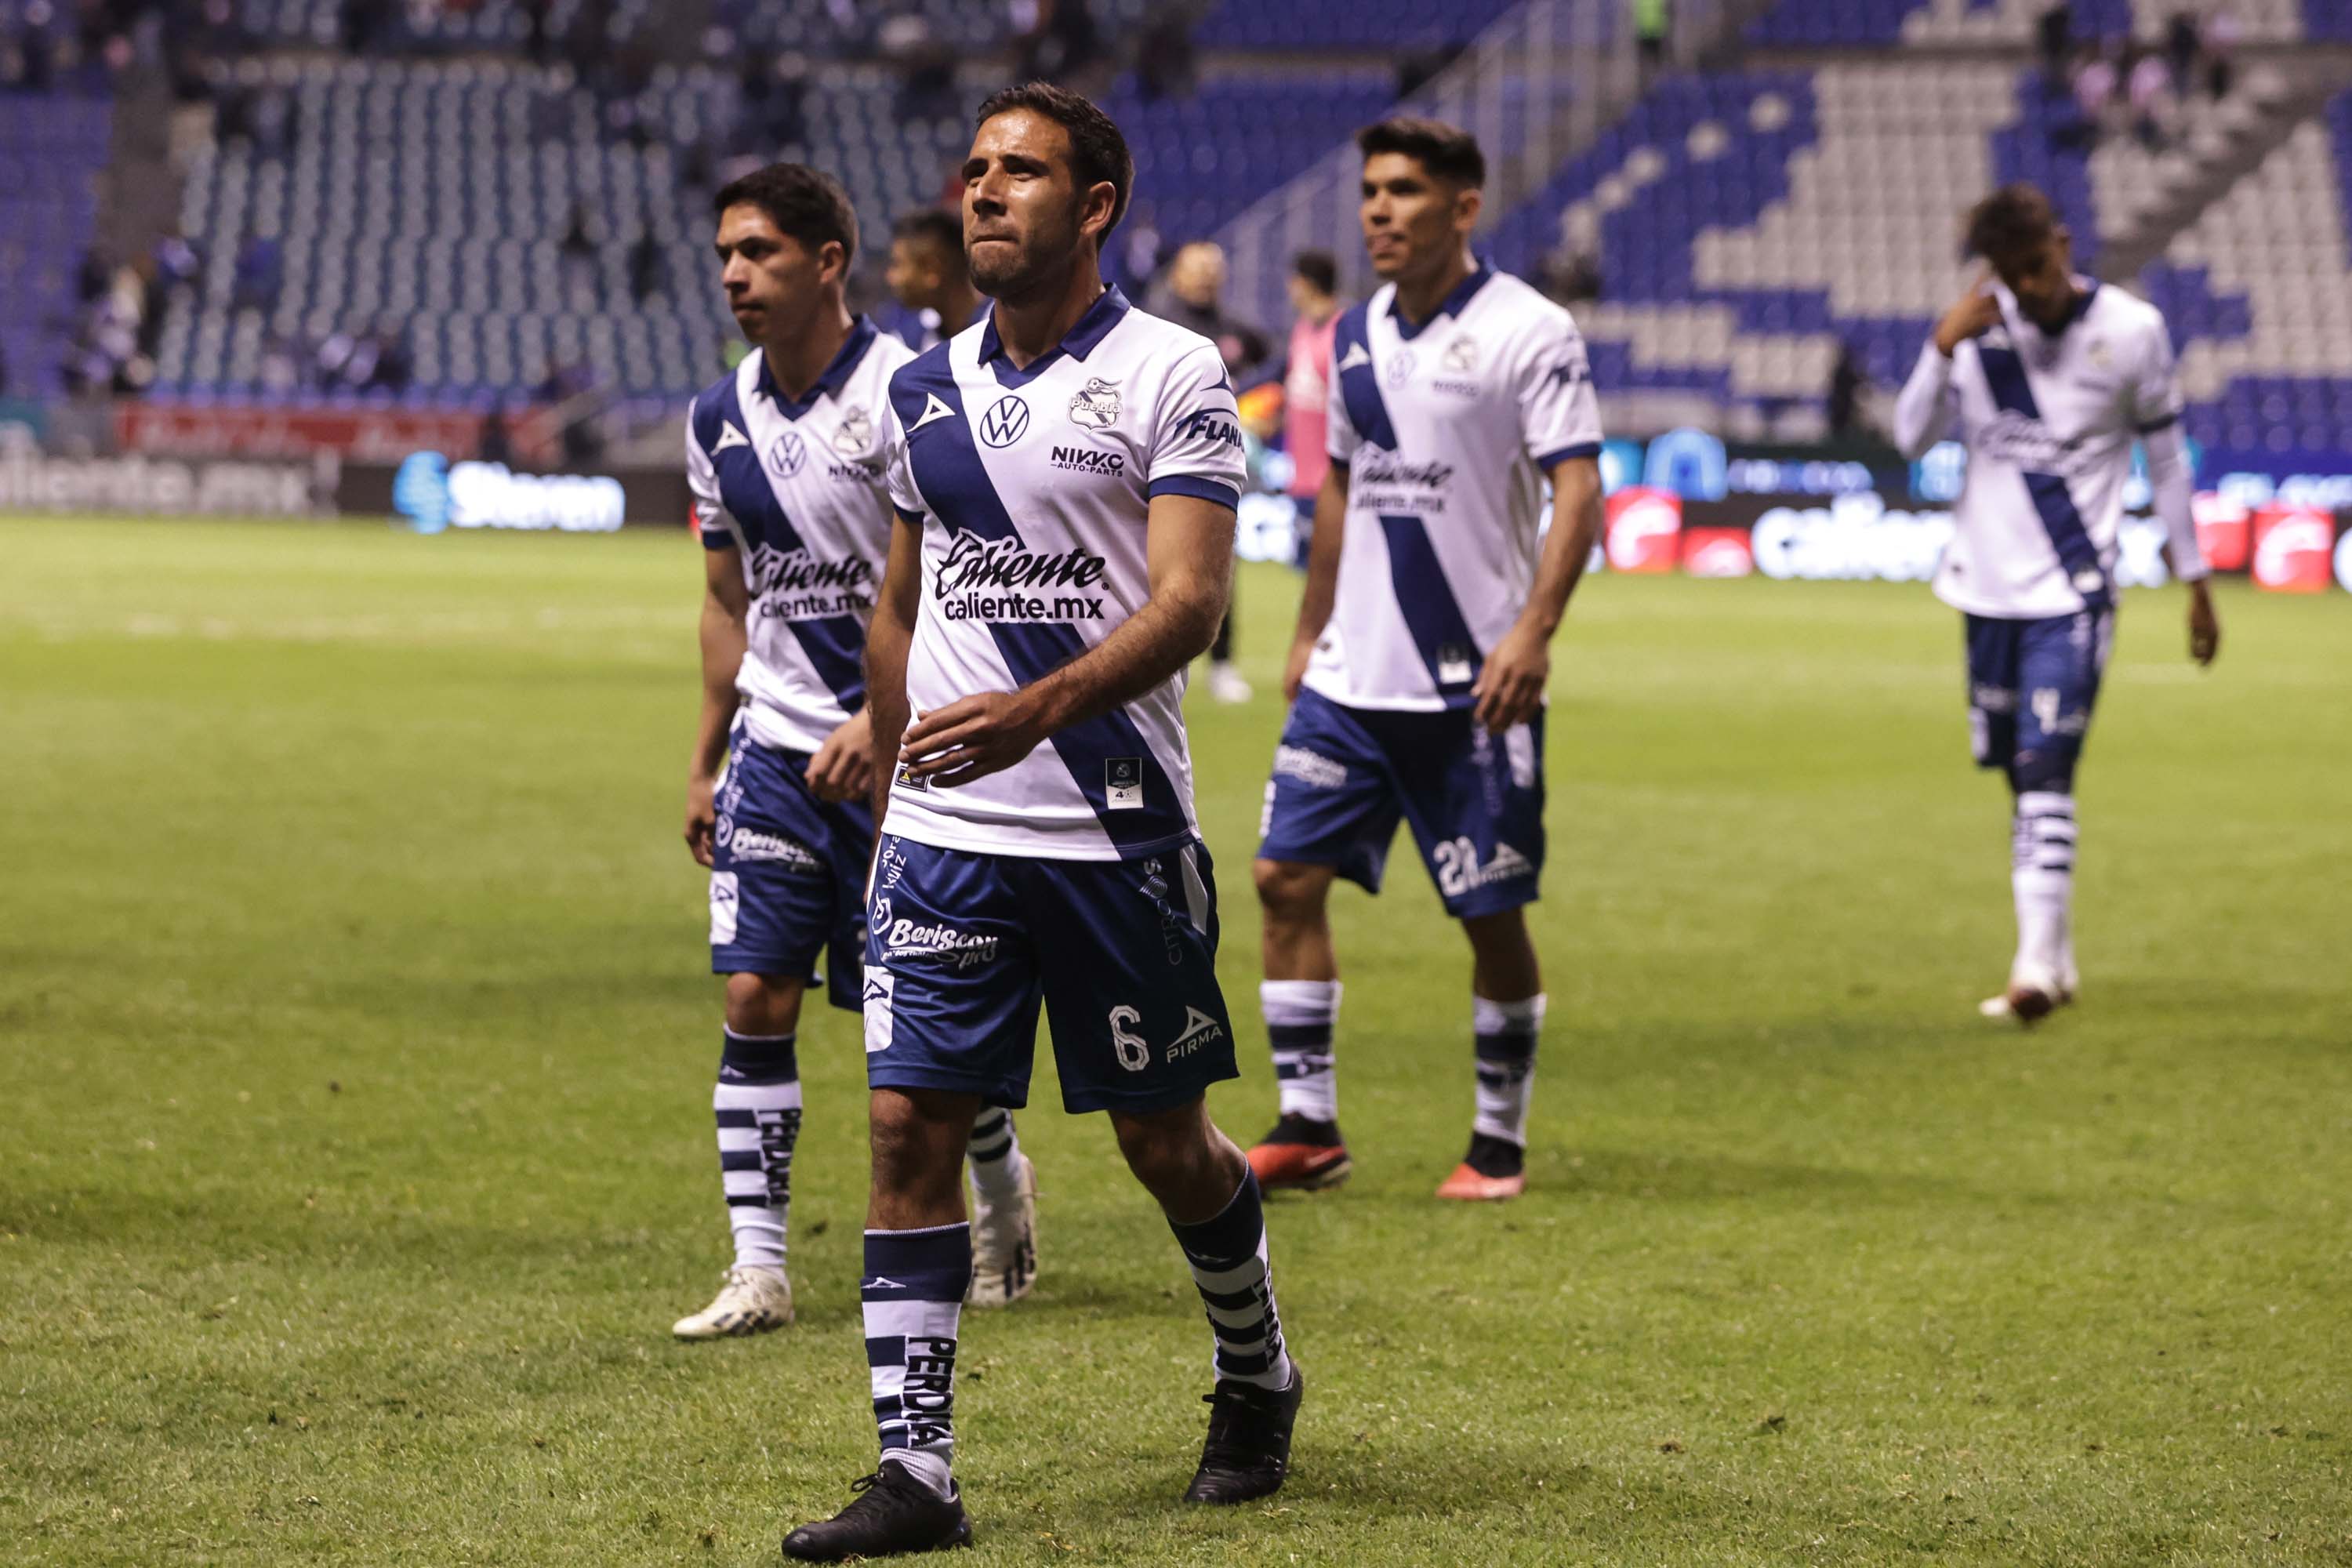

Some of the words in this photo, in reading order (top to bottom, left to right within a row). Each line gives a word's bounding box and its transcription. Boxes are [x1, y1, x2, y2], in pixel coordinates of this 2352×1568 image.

[1071, 398, 1122, 415] Puebla
[1051, 445, 1124, 470] NIKKO
[935, 532, 1105, 601] Caliente
[945, 592, 1105, 620] caliente.mx
[1109, 1005, 1150, 1072] 6
[1167, 1025, 1223, 1063] PIRMA
